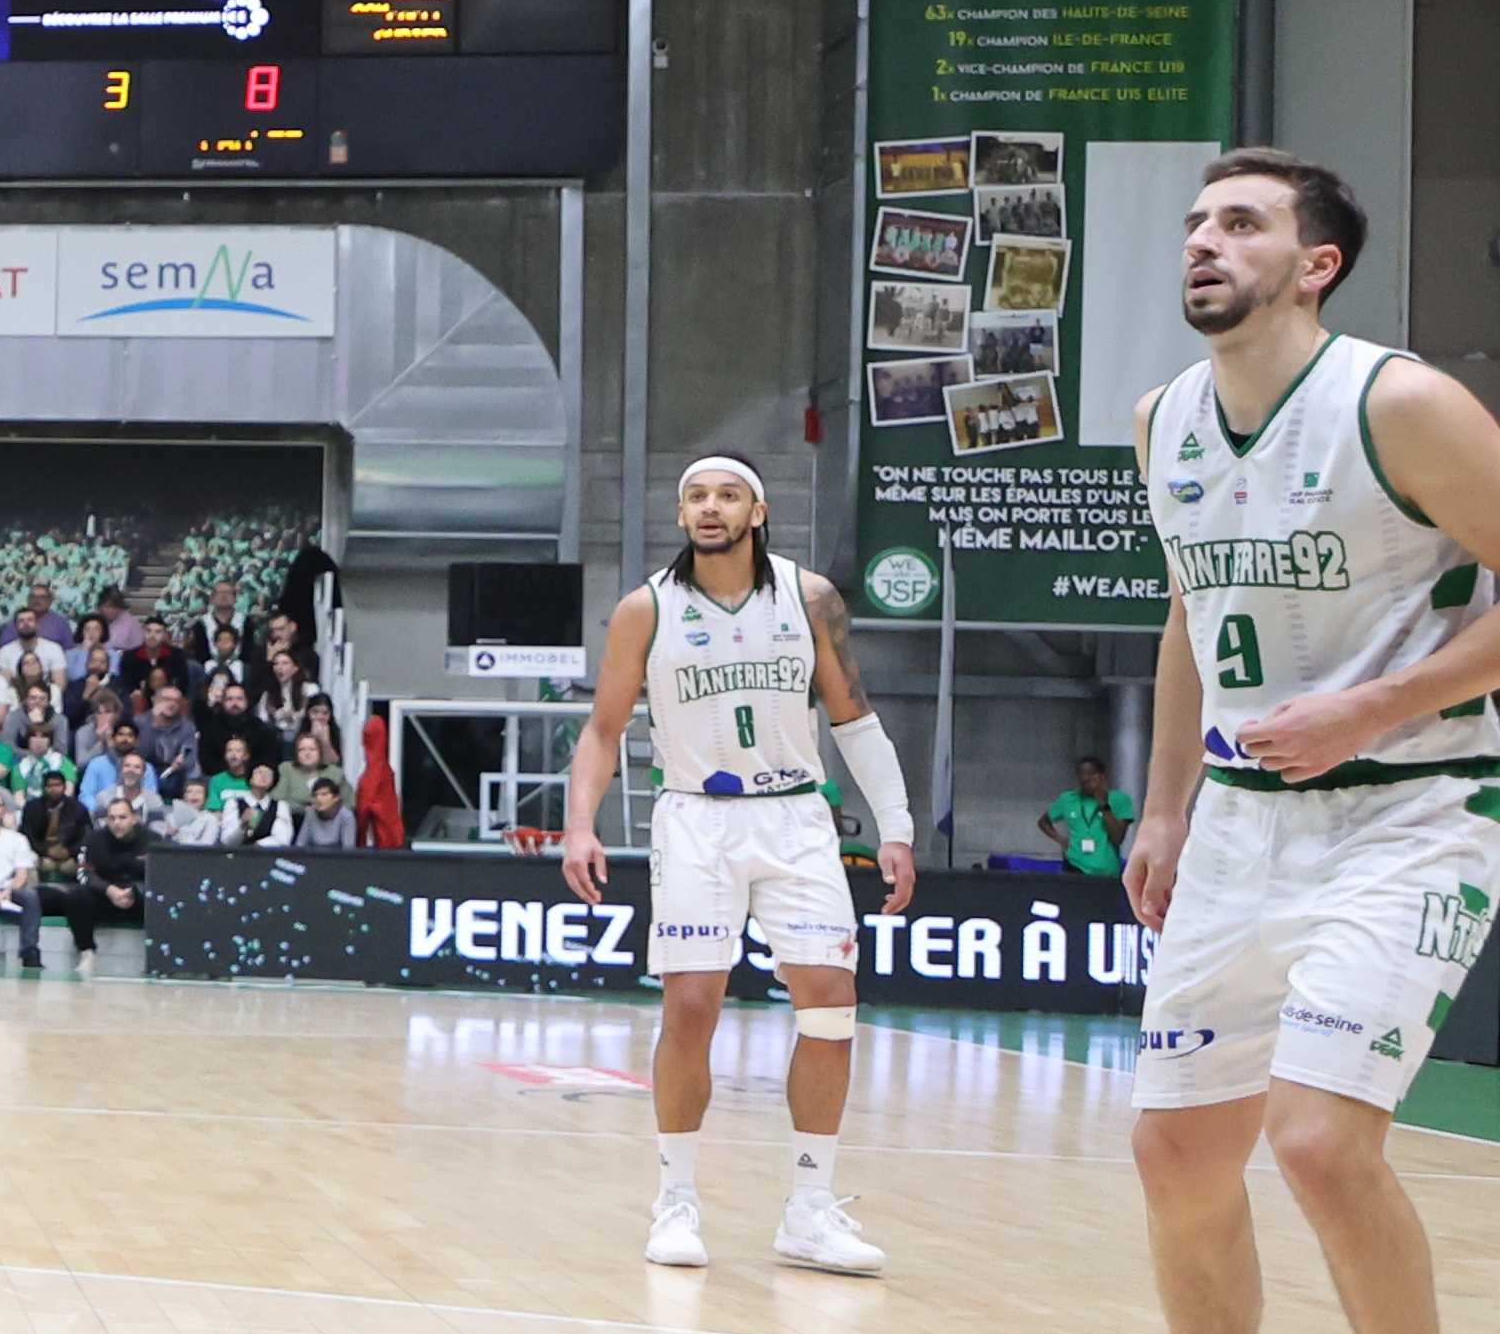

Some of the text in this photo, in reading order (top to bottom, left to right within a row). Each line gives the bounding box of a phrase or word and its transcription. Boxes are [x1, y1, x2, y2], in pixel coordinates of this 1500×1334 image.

[957, 9, 1028, 20] CHAMPION
[1062, 6, 1190, 19] HAUTS-DE-SEINE
[976, 33, 1172, 47] CHAMPION ILE-DE-FRANCE
[957, 61, 1152, 75] VICE-CHAMPION DE FRANCE
[103, 71, 131, 109] 3
[245, 65, 280, 111] 8
[949, 90, 1021, 102] CHAMPION
[1025, 90, 1043, 101] DE
[1049, 88, 1110, 101] FRANCE
[1148, 88, 1188, 100] ELITE
[912, 466, 937, 483] NE
[941, 466, 1016, 485] TOUCHE
[1020, 468, 1053, 485] PAS
[1057, 468, 1108, 486] TOUS
[1113, 469, 1134, 486] LE
[874, 483, 1131, 505] MÊME SUR LES ÉPAULES D'UN
[977, 507, 1006, 523] ON
[1011, 507, 1072, 525] PORTE
[1076, 508, 1128, 525] TOUS
[888, 557, 916, 570] WE
[880, 578, 928, 603] JSF
[499, 652, 580, 665] IMMOBEL
[1216, 614, 1264, 689] 9
[675, 655, 806, 704] NANTERRE92
[734, 705, 756, 749] 8
[410, 899, 1067, 982] VENEZ À
